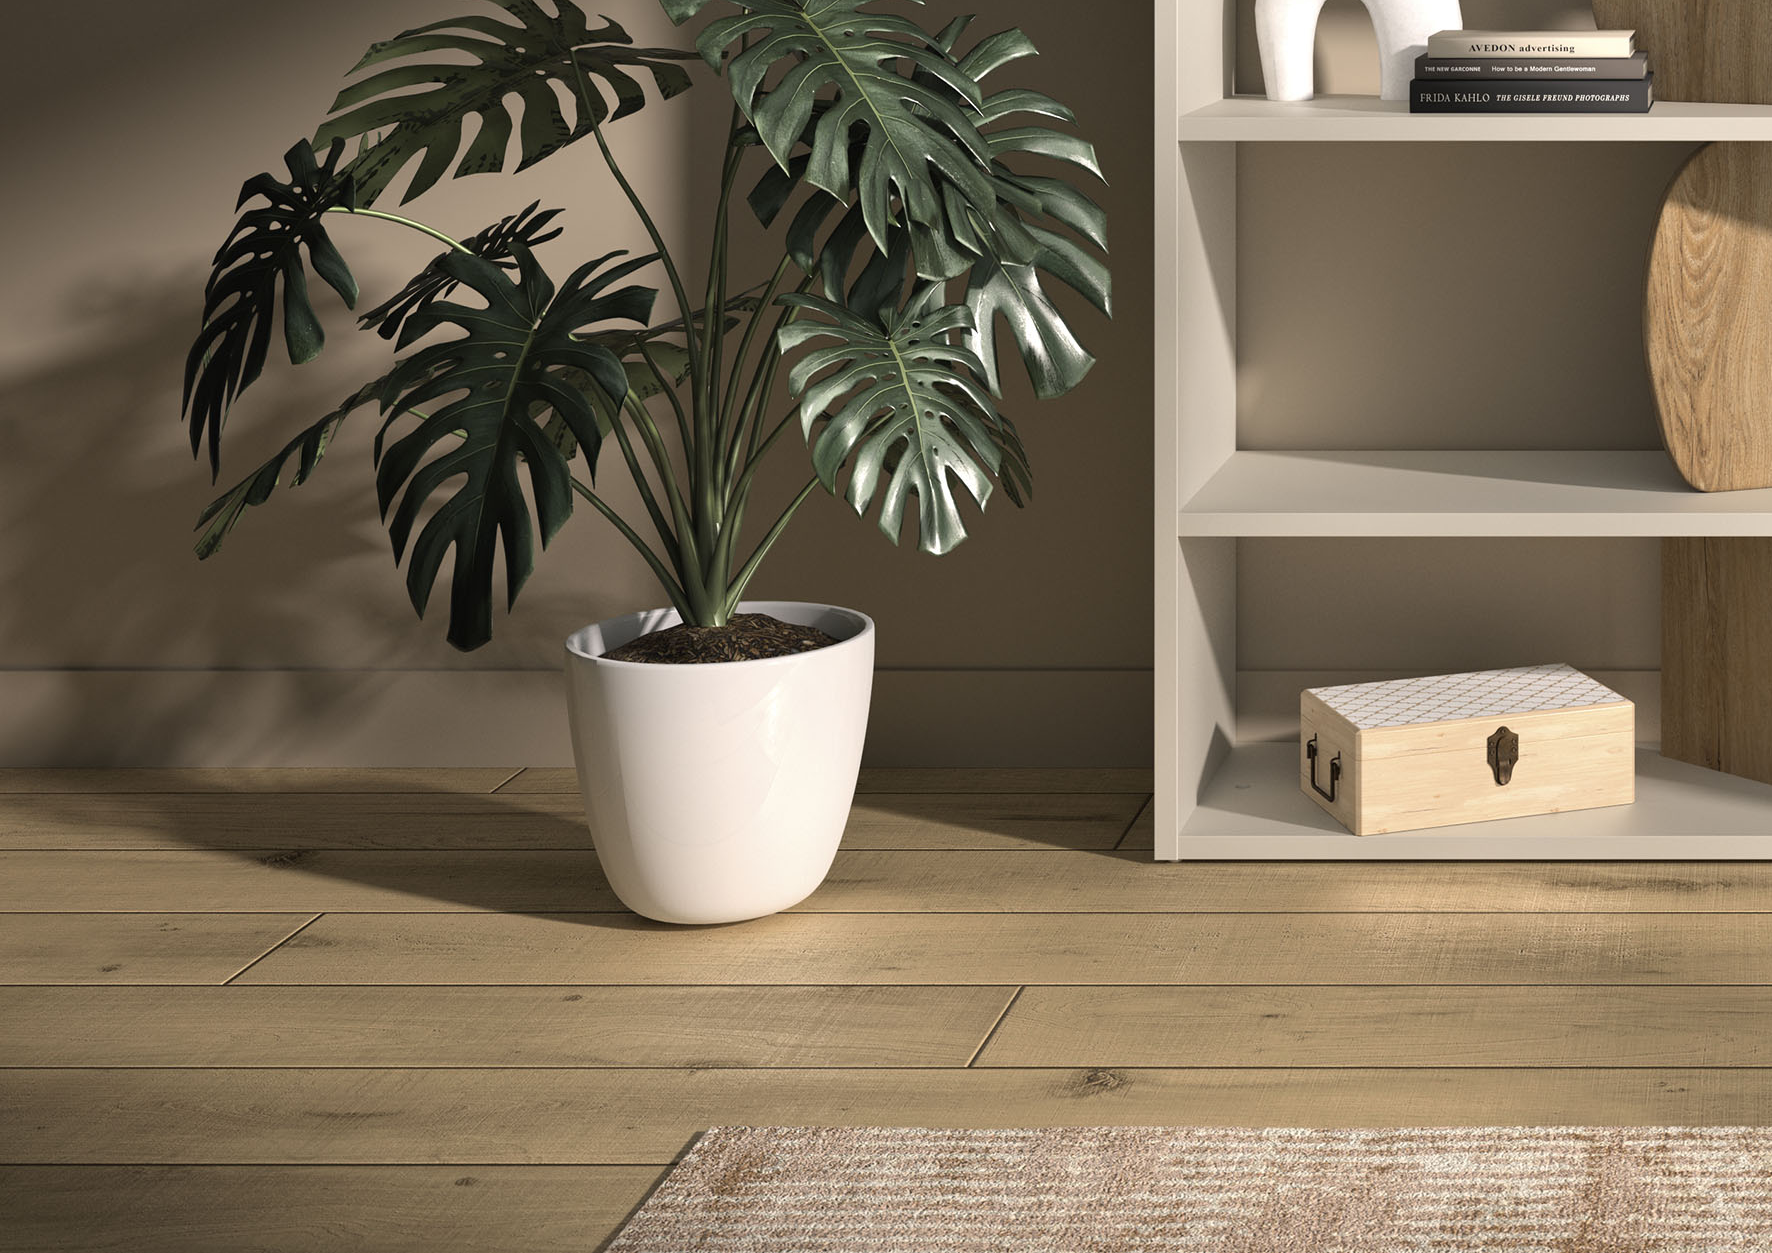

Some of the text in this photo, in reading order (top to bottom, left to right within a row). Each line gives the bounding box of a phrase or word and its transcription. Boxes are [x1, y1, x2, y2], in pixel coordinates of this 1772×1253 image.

[1469, 44, 1575, 54] AVEDON advertising
[1420, 93, 1630, 103] FRIDA KAHLO THE GISELE FREUND PHOTOGRAPHS
